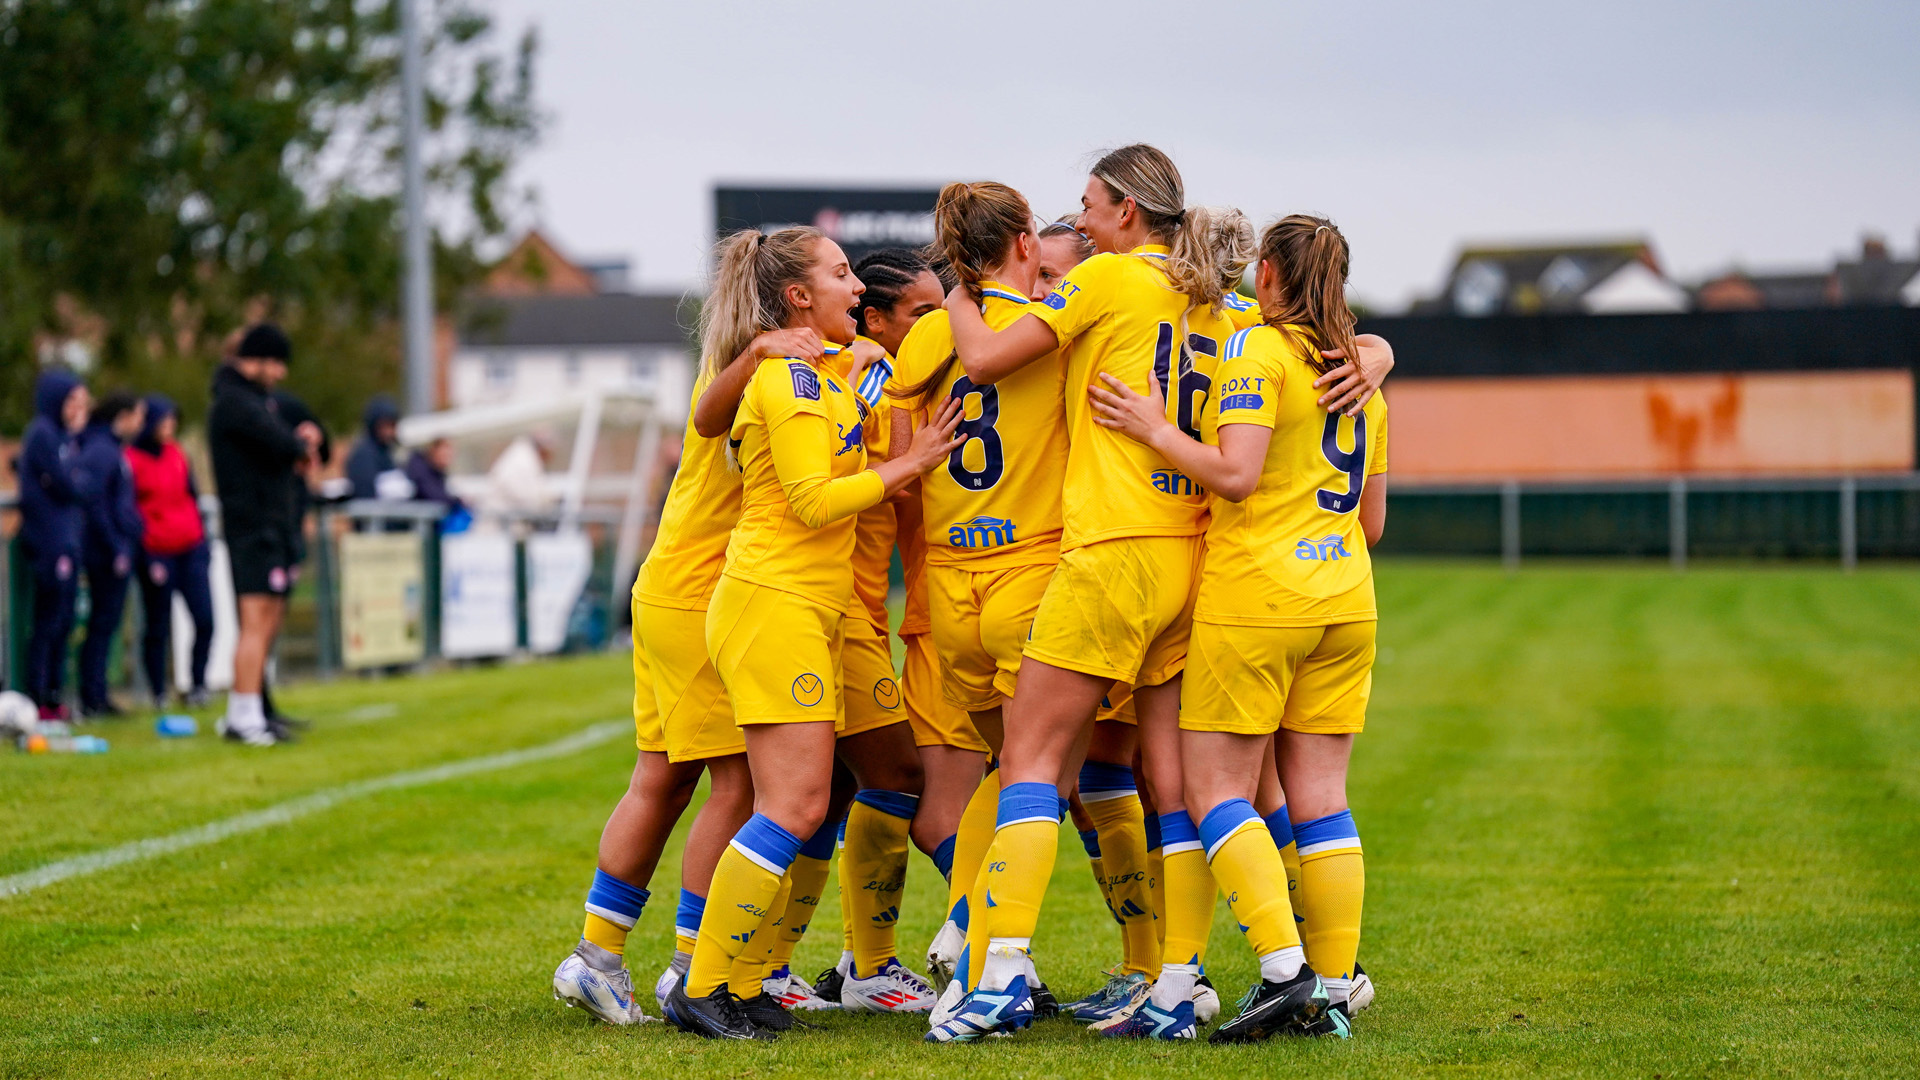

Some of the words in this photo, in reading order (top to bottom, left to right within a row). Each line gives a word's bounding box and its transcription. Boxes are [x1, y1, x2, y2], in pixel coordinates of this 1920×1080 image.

[1153, 321, 1218, 443] 16
[1221, 376, 1265, 397] BOXT
[1223, 395, 1254, 410] LIFE
[947, 374, 1005, 492] 8
[1316, 402, 1367, 515] 9
[1150, 472, 1205, 496] am
[948, 517, 1019, 548] amt
